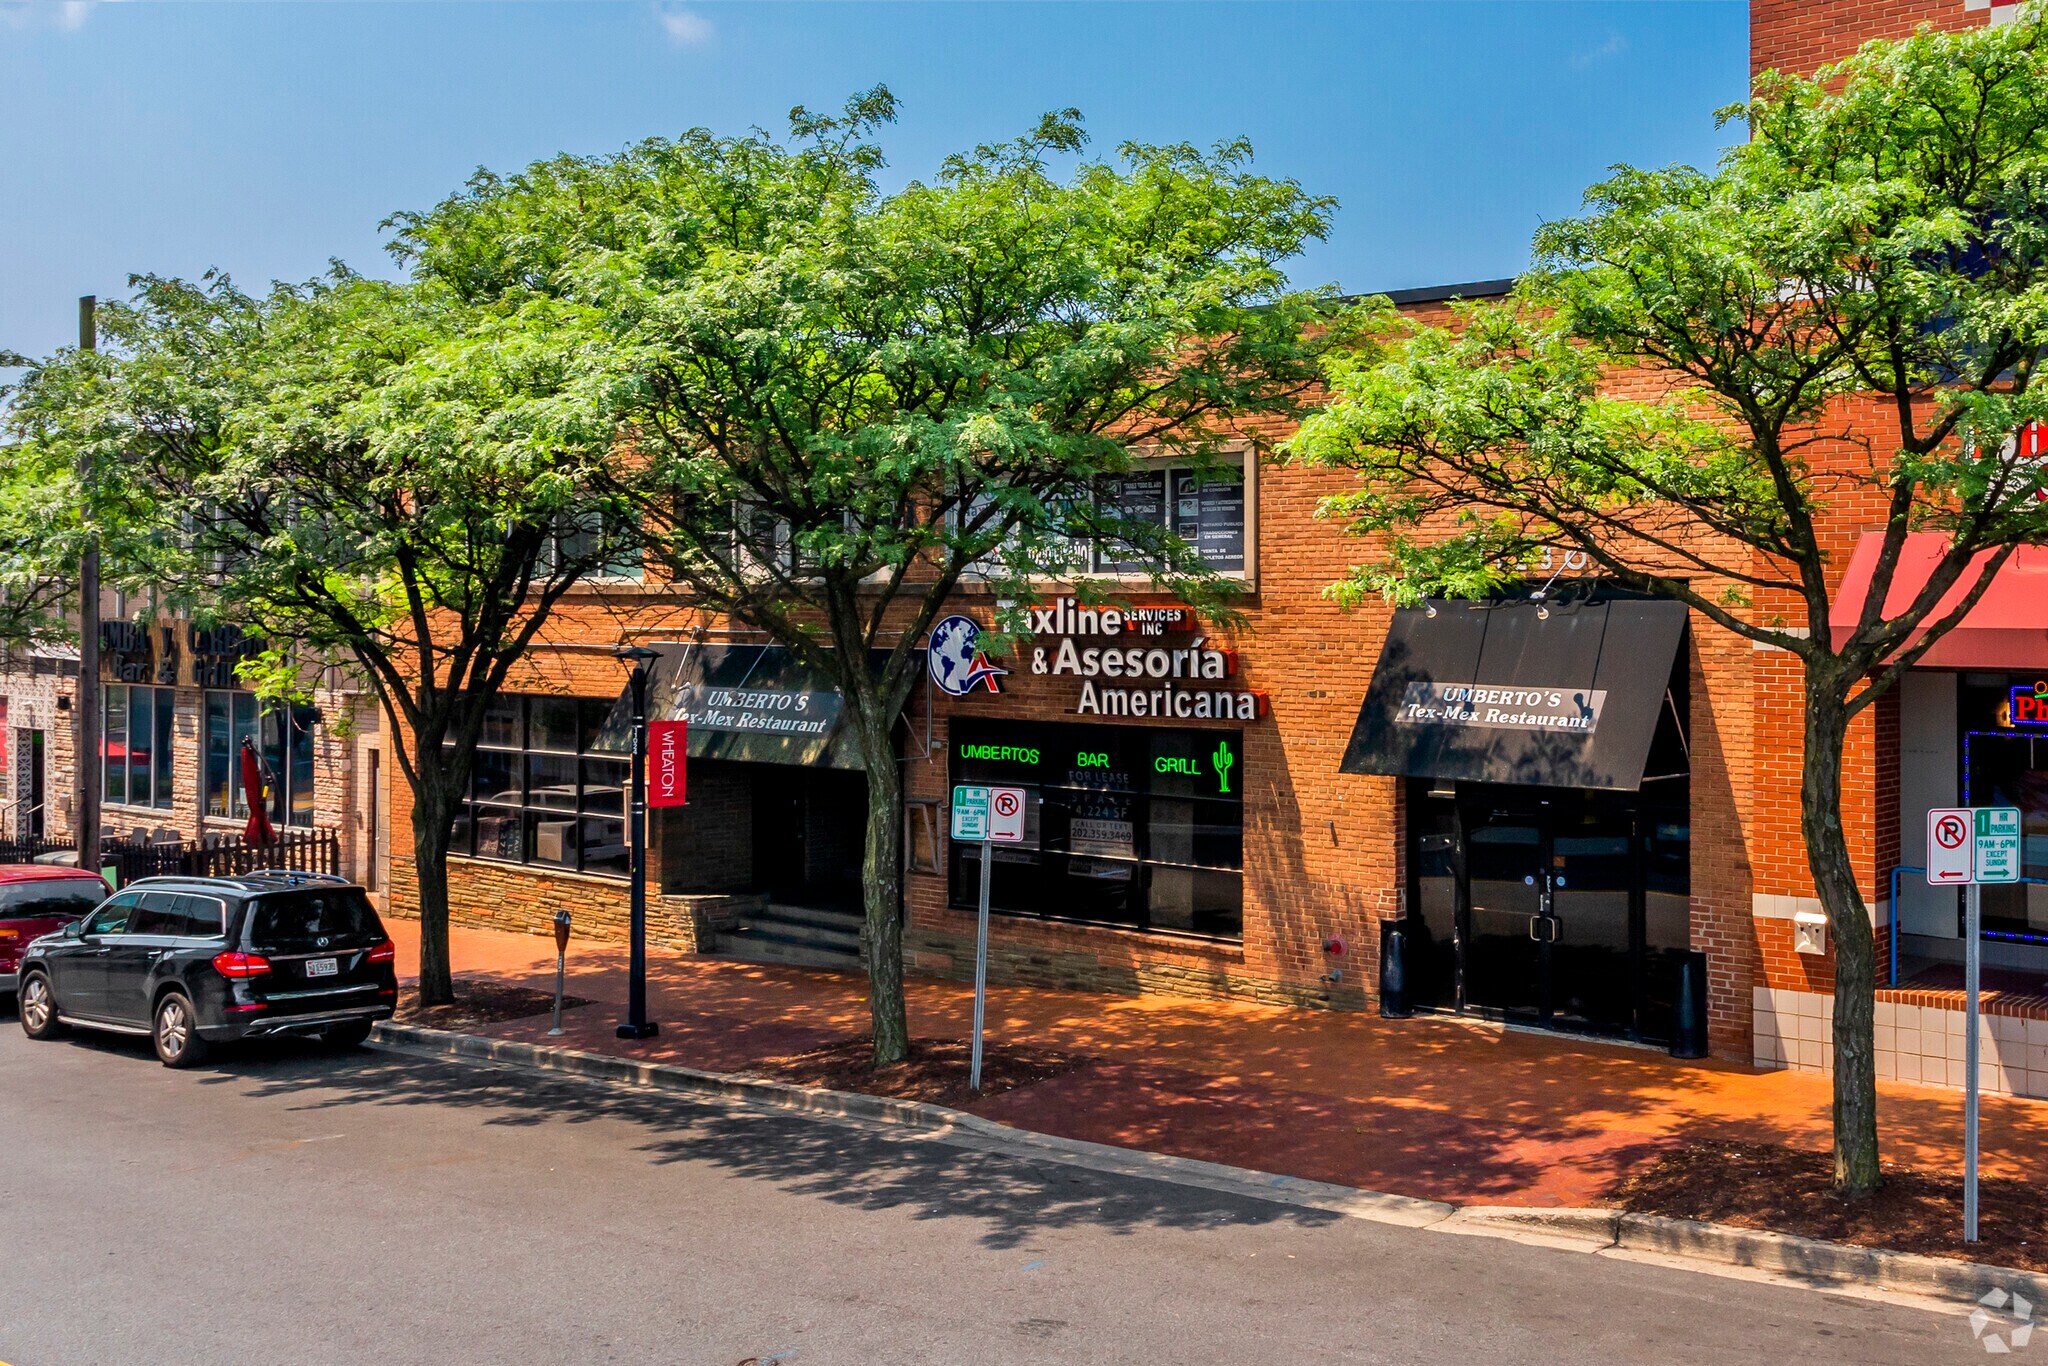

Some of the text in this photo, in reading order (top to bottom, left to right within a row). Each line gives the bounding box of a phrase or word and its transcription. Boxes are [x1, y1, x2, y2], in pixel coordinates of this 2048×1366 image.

[1123, 608, 1182, 622] SERVICES
[1142, 622, 1163, 636] INC
[1032, 636, 1224, 679] & Asesoría
[707, 691, 809, 711] UMBERTO'S
[1077, 679, 1256, 720] Americana
[1443, 687, 1562, 707] UMBERTO'S
[736, 712, 827, 733] Restaurant
[1407, 704, 1590, 729] Tex-Mex Restaurant
[960, 744, 1040, 764] UMBERTOS
[1077, 752, 1110, 768] BAR
[661, 730, 675, 797] WHEATON
[1154, 757, 1202, 775] GRILL
[1068, 770, 1129, 783] FOR LEASE
[966, 798, 986, 806] PARKING
[1113, 807, 1127, 818] SF
[1999, 812, 2008, 821] HR
[1981, 814, 1985, 833] 1
[1990, 823, 2016, 834] PARKING
[1072, 827, 1132, 841] 202.359.3469
[1985, 850, 2008, 858] EXCEPT
[1985, 858, 2008, 867] SUNDAY
